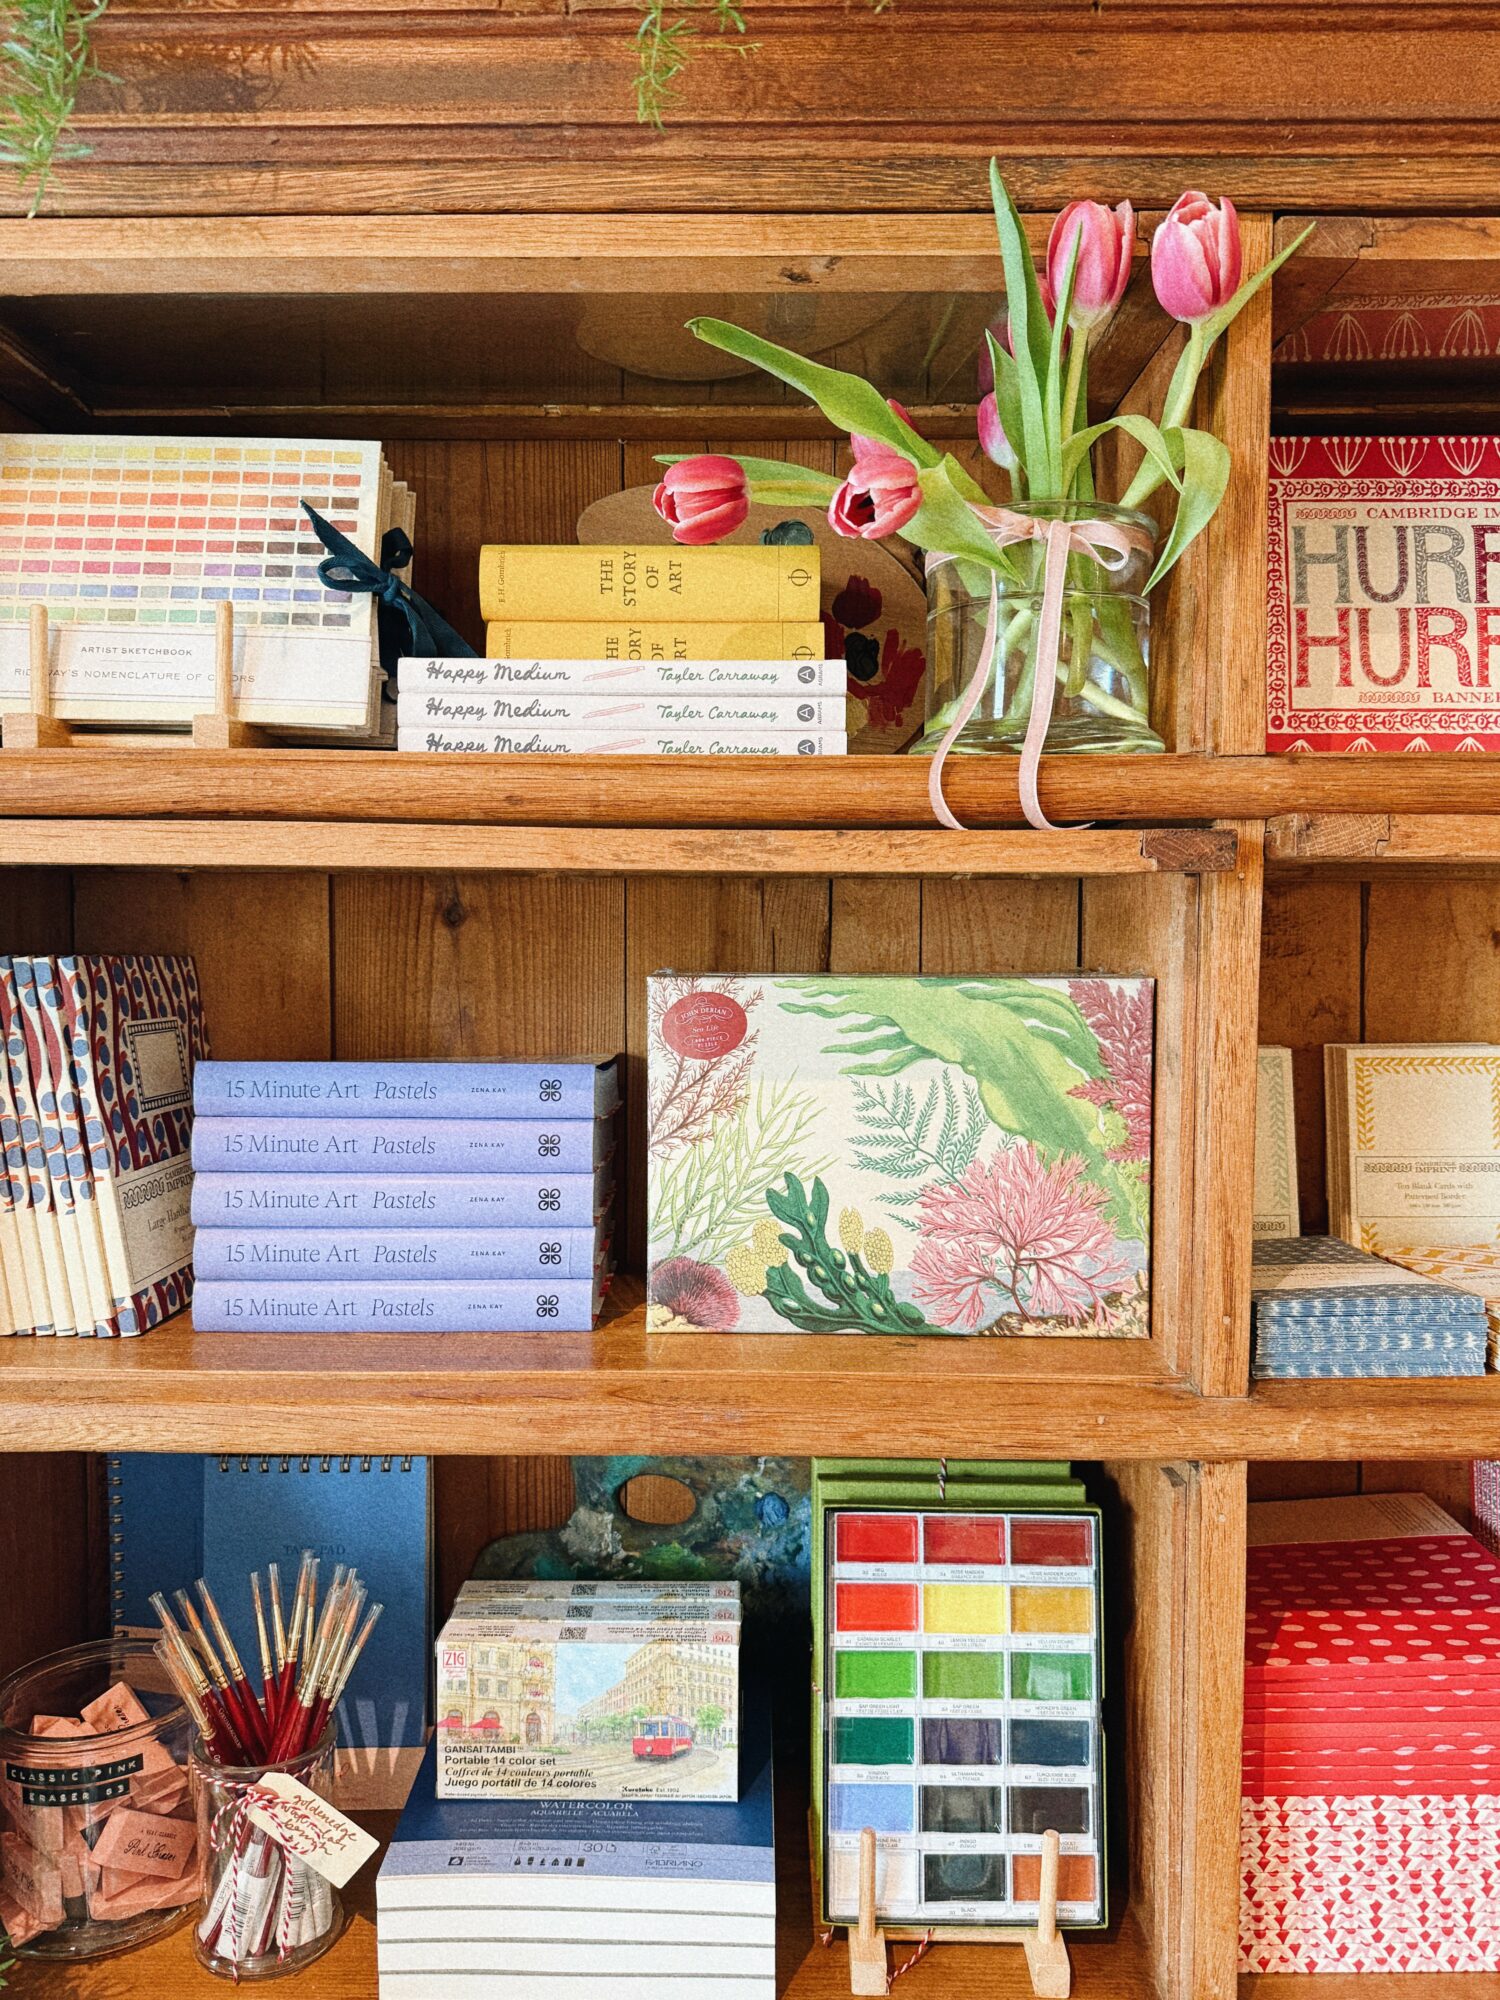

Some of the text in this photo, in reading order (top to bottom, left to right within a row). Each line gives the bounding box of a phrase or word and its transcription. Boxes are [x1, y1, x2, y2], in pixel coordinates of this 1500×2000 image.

[1366, 507, 1478, 519] CAMBRIDGE
[600, 559, 614, 595] THE
[624, 551, 636, 606] STORY
[646, 565, 659, 589] OF
[669, 560, 682, 595] ART
[80, 646, 192, 656] ARTIST SKETCHBOOK
[606, 636, 619, 660] HE
[628, 628, 642, 660] ORY
[674, 638, 686, 660] RT
[84, 670, 181, 681] NOMENCLATURE
[186, 673, 202, 682] OF
[208, 674, 256, 683] CORS
[426, 660, 571, 684] Happy Medium
[657, 667, 779, 686] Tayler Carraway
[426, 697, 570, 721] Happy Medium
[656, 704, 778, 722] Tayler Carraway
[426, 732, 571, 752] Happy Medium
[700, 1008, 727, 1016] DERIAN
[226, 1079, 438, 1100] 15 Minute Art Pastels
[224, 1134, 436, 1154] 15 Minute Art Pastels
[224, 1190, 436, 1210] 15 Minute Art Pastels
[226, 1244, 437, 1264] 15 Minute Art Pastels
[224, 1298, 434, 1318] 15 Minute Art Pastels
[444, 1652, 465, 1666] ZIG
[444, 1746, 482, 1754] GANSAI
[11, 1760, 136, 1782] CLASSIC PINK
[444, 1756, 556, 1766] Portable 14 color set
[445, 1766, 594, 1778] Coffret de 14 couleurs portable
[444, 1778, 597, 1788] Juego portátil de 14 colores
[29, 1792, 90, 1802] ERASER
[540, 1801, 634, 1810] WATERCOLOR
[582, 1842, 603, 1852] 30
